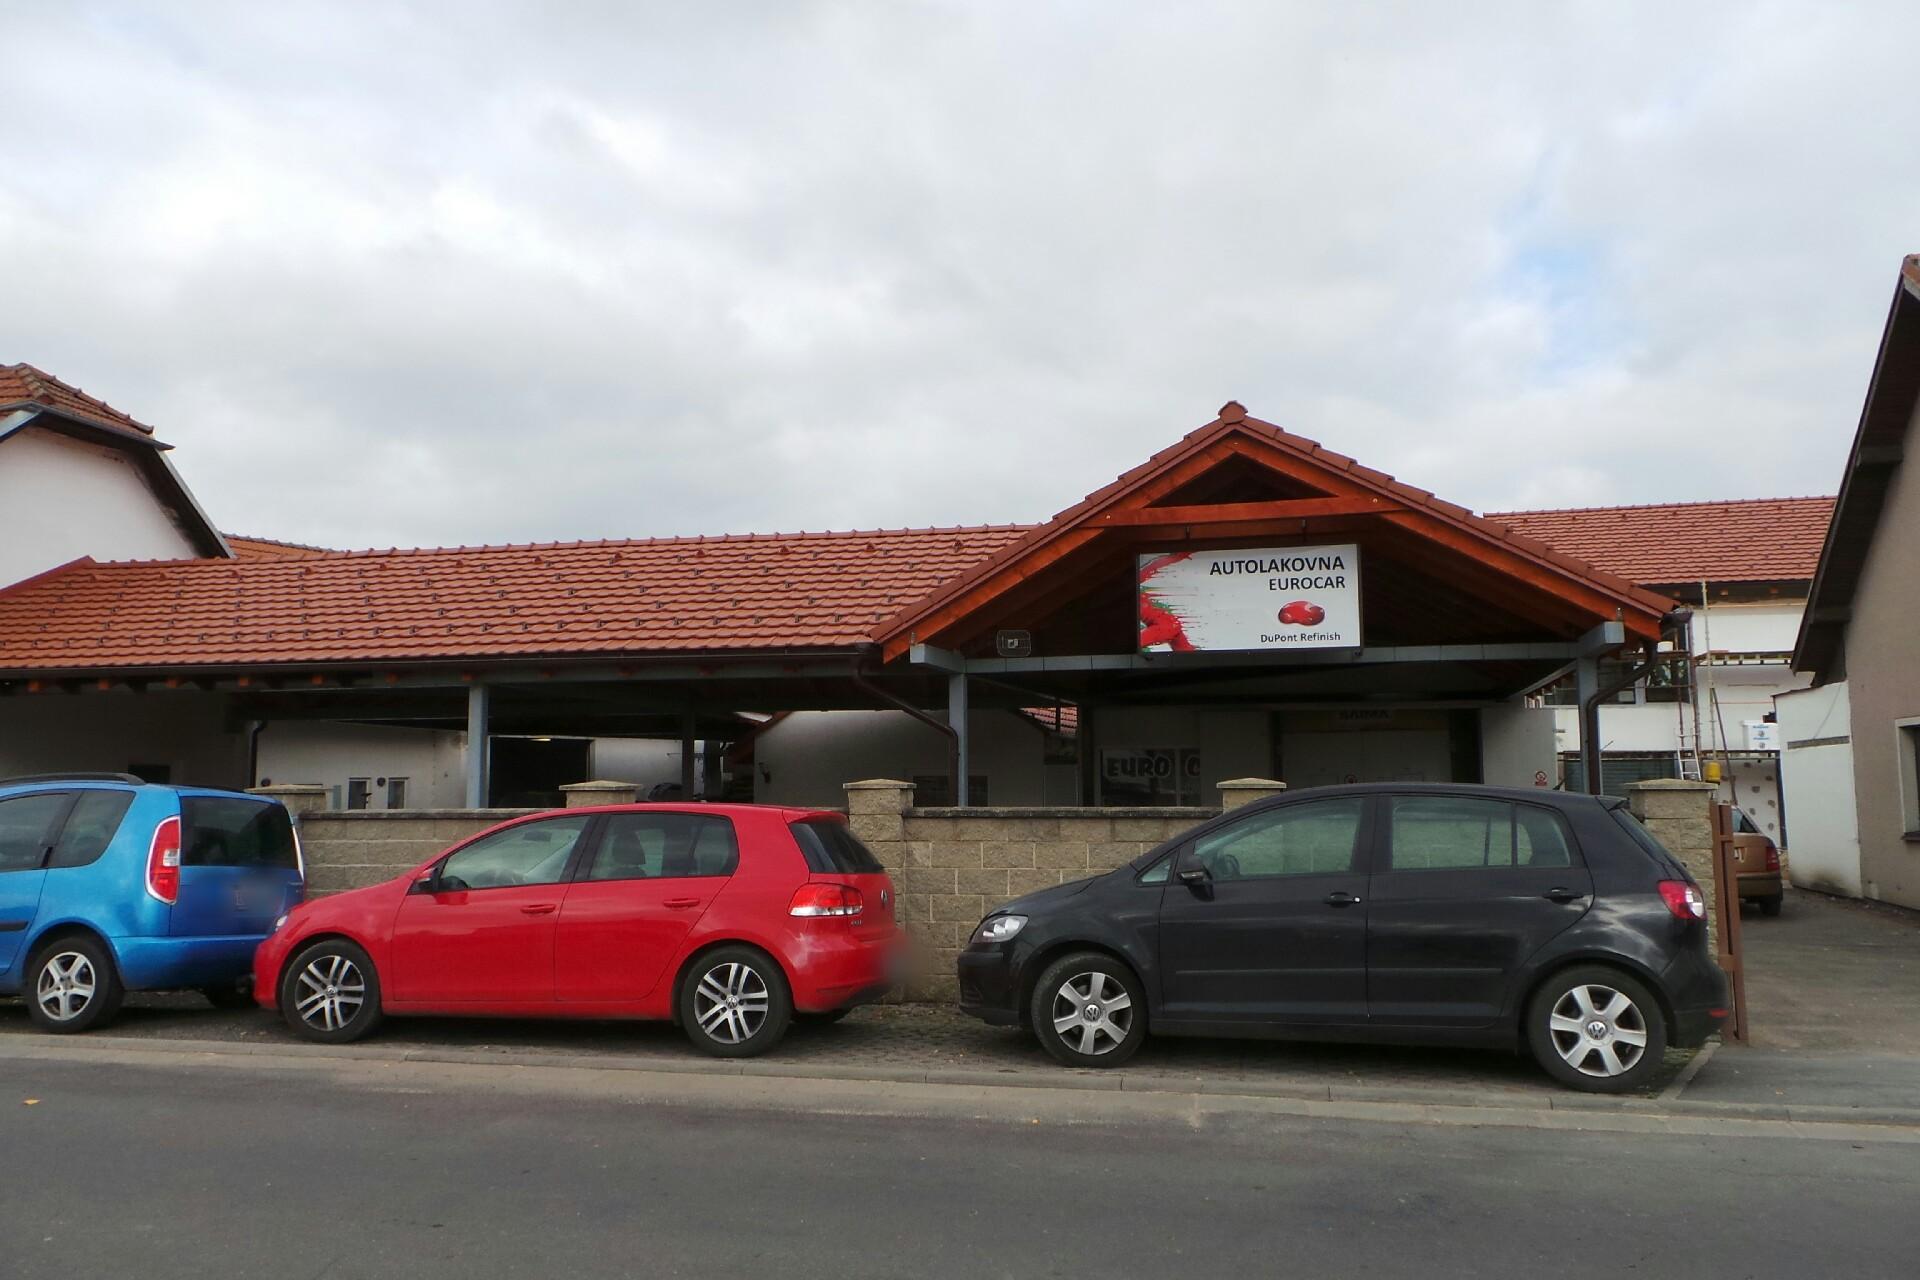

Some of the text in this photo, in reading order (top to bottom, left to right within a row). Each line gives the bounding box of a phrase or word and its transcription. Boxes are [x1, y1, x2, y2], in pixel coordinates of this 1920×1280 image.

[1209, 555, 1345, 576] AUTOLAKOVNA
[1269, 575, 1346, 591] EUROCAR
[1260, 631, 1341, 643] DuPont Refinish
[1106, 757, 1170, 777] EURO
